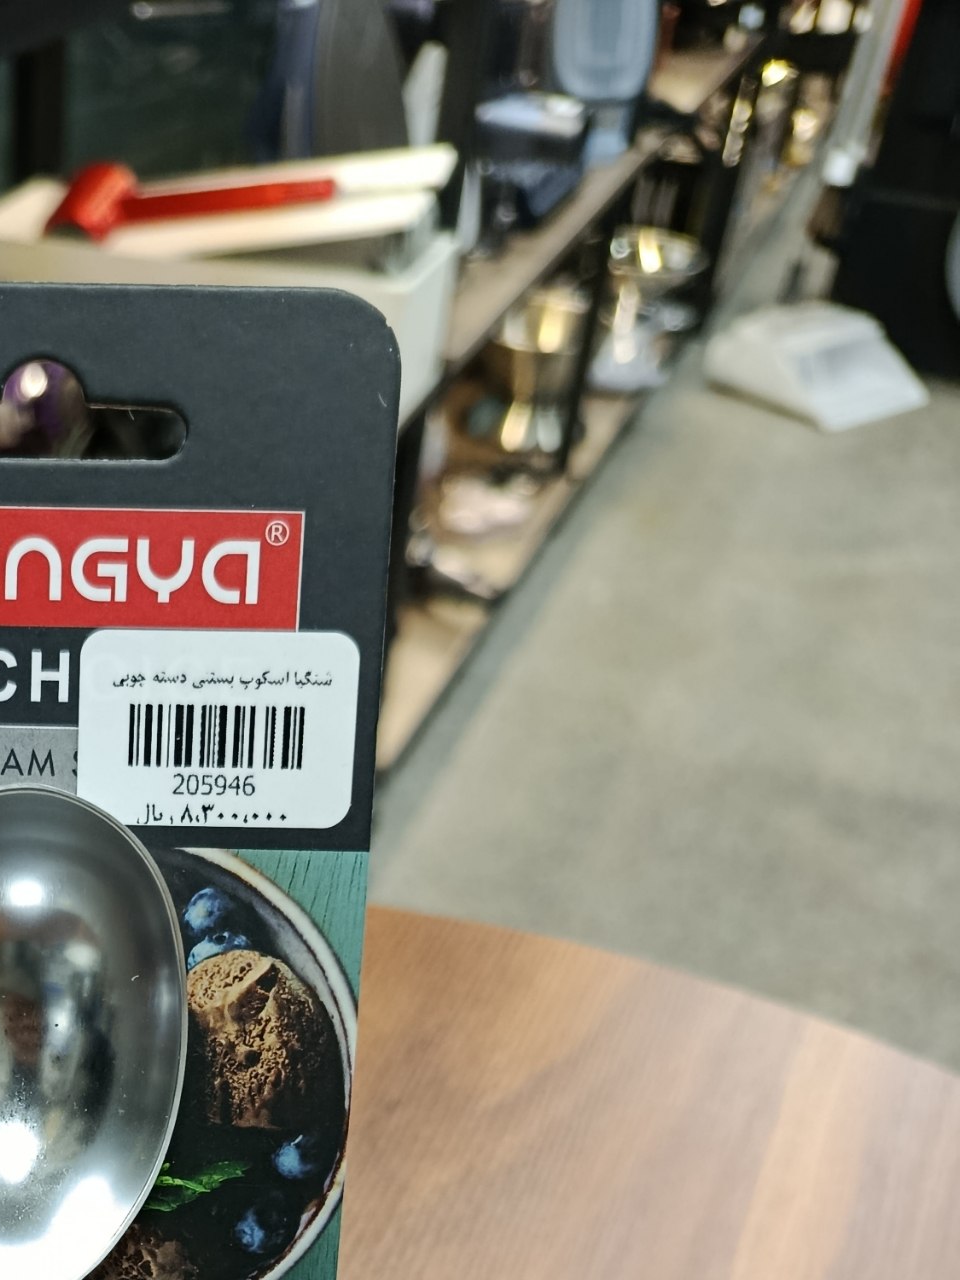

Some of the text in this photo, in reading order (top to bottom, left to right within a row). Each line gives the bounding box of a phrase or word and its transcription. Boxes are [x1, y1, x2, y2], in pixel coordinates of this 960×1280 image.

[152, 671, 187, 684] دسته
[192, 671, 234, 689] بستنی
[238, 670, 290, 691] اسکوپ
[172, 773, 256, 797] 205946
